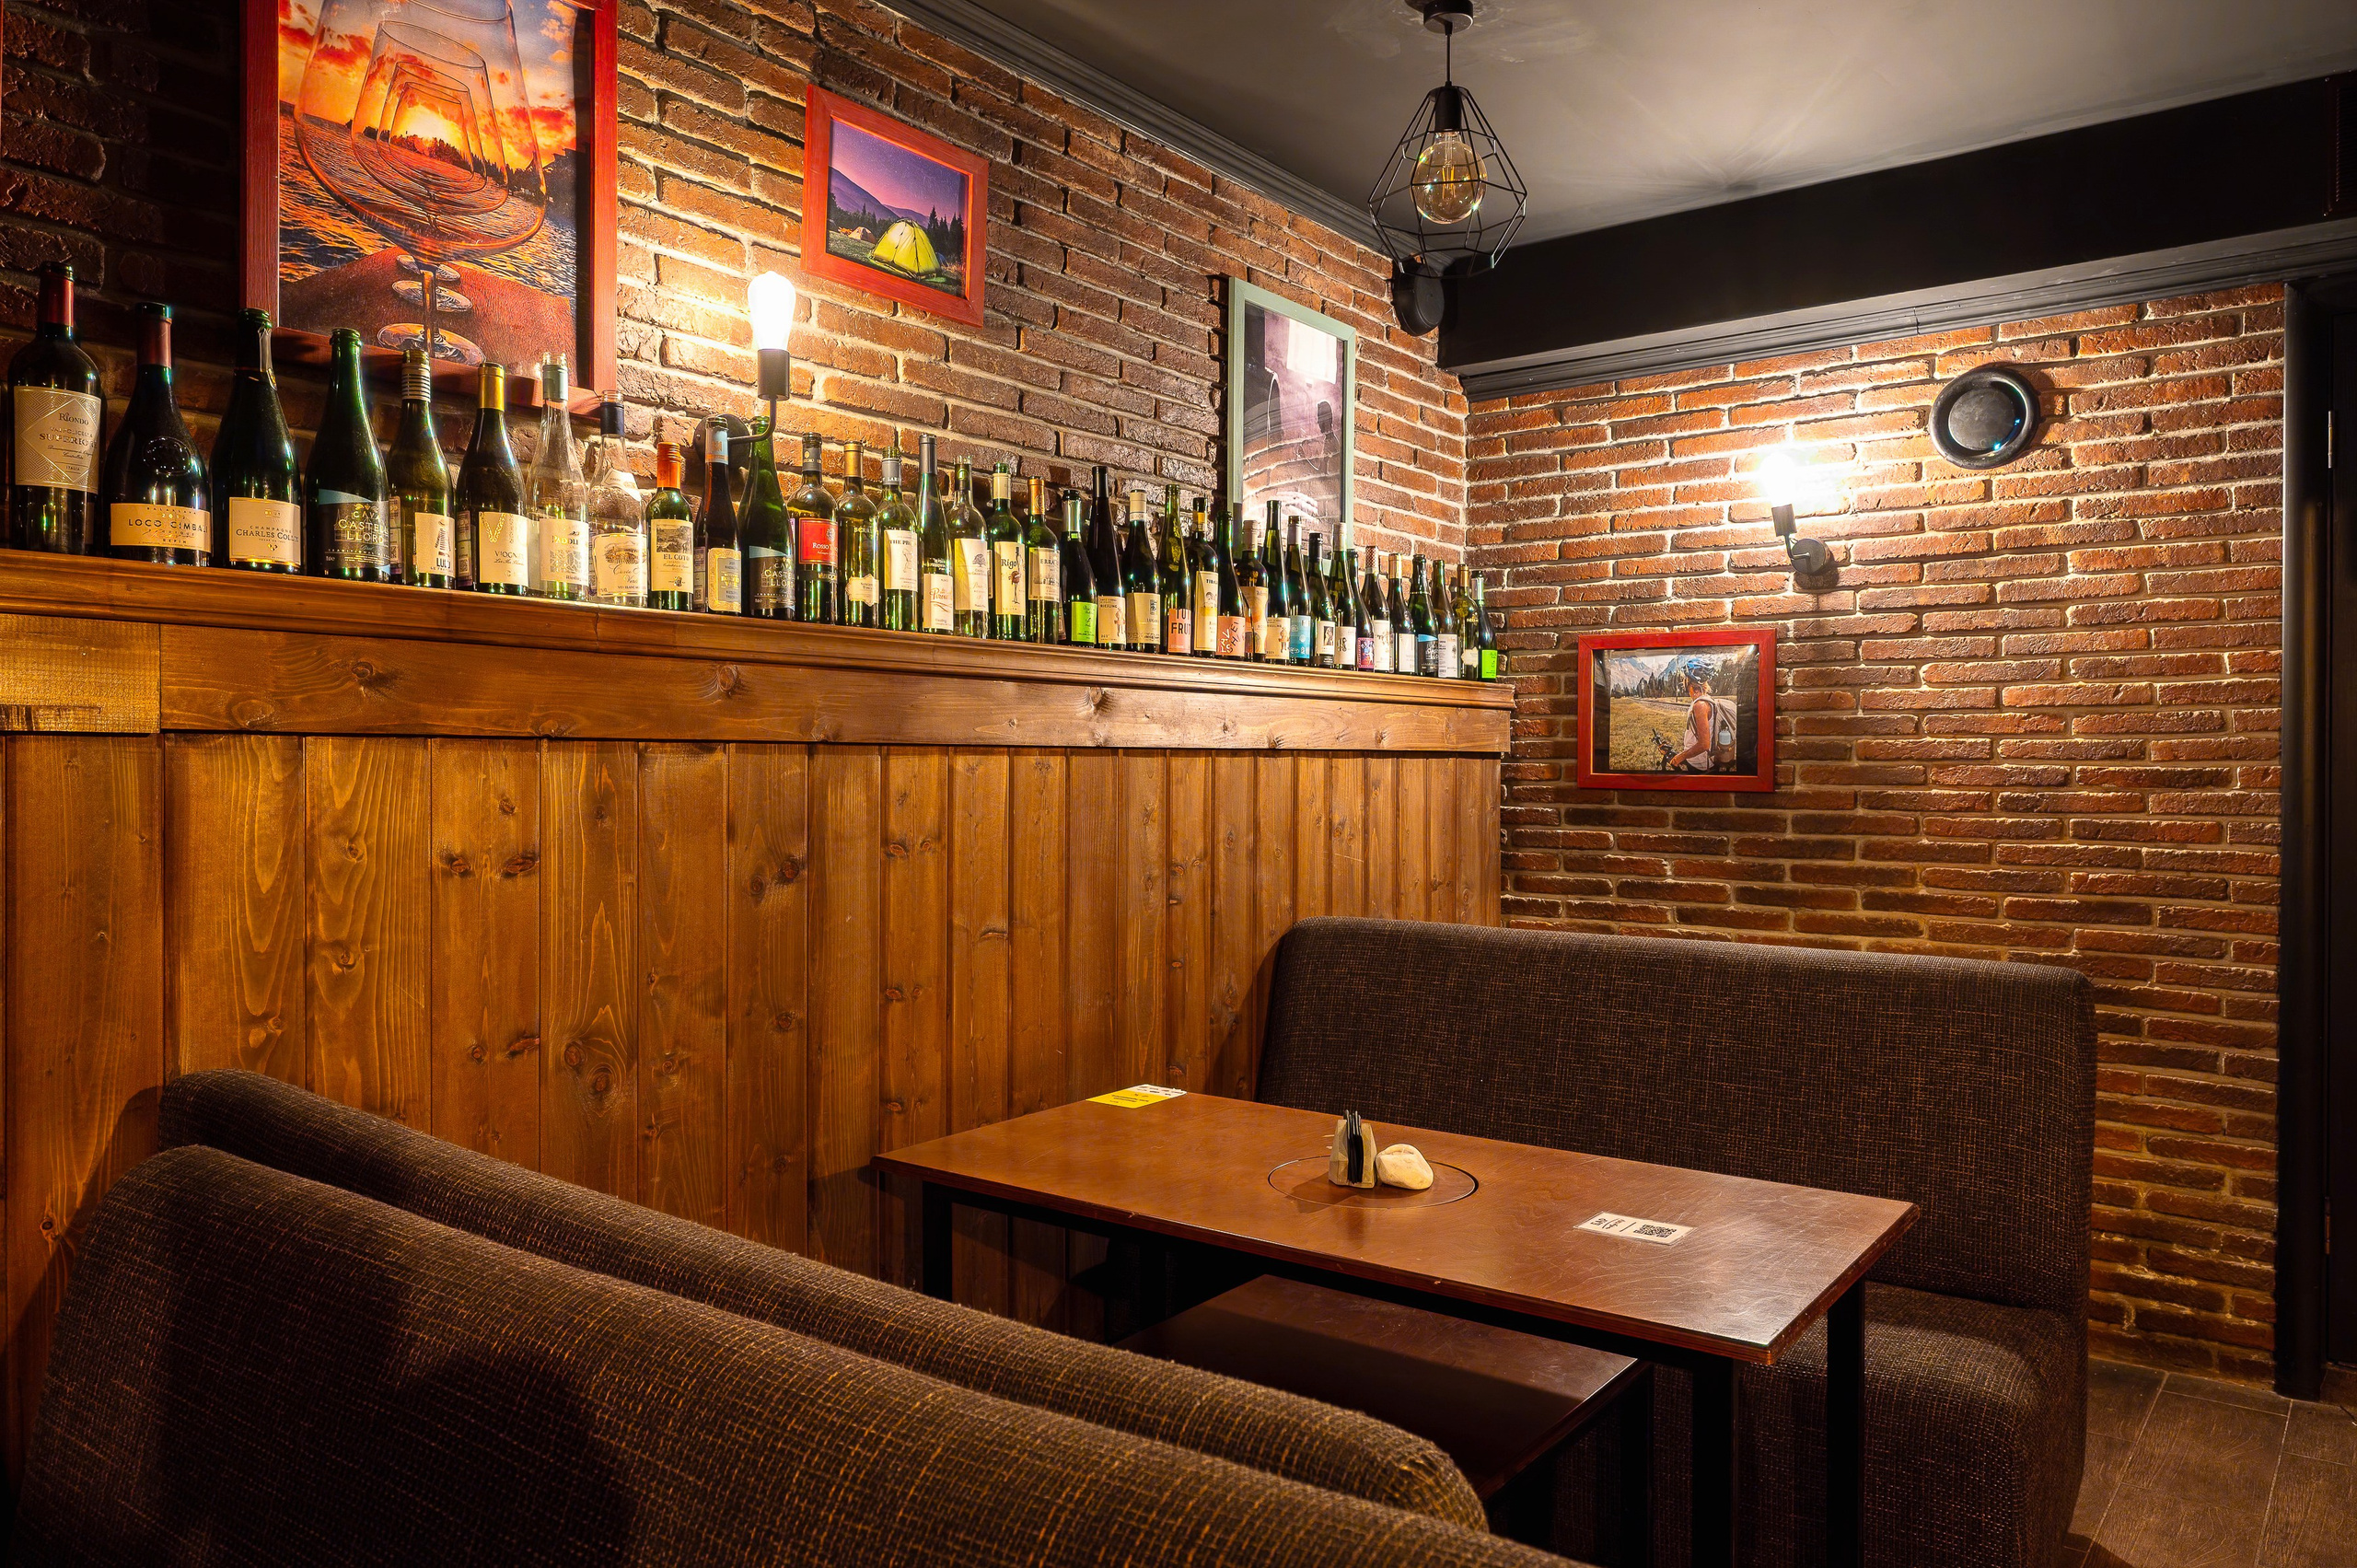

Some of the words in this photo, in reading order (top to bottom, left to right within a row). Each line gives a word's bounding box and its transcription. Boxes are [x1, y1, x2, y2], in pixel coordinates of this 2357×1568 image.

[129, 518, 162, 528] LOCO
[236, 528, 275, 539] CHARLES
[250, 525, 292, 533] CHAMPAGNE
[346, 531, 385, 544] LLORD
[1001, 558, 1017, 570] Rigo
